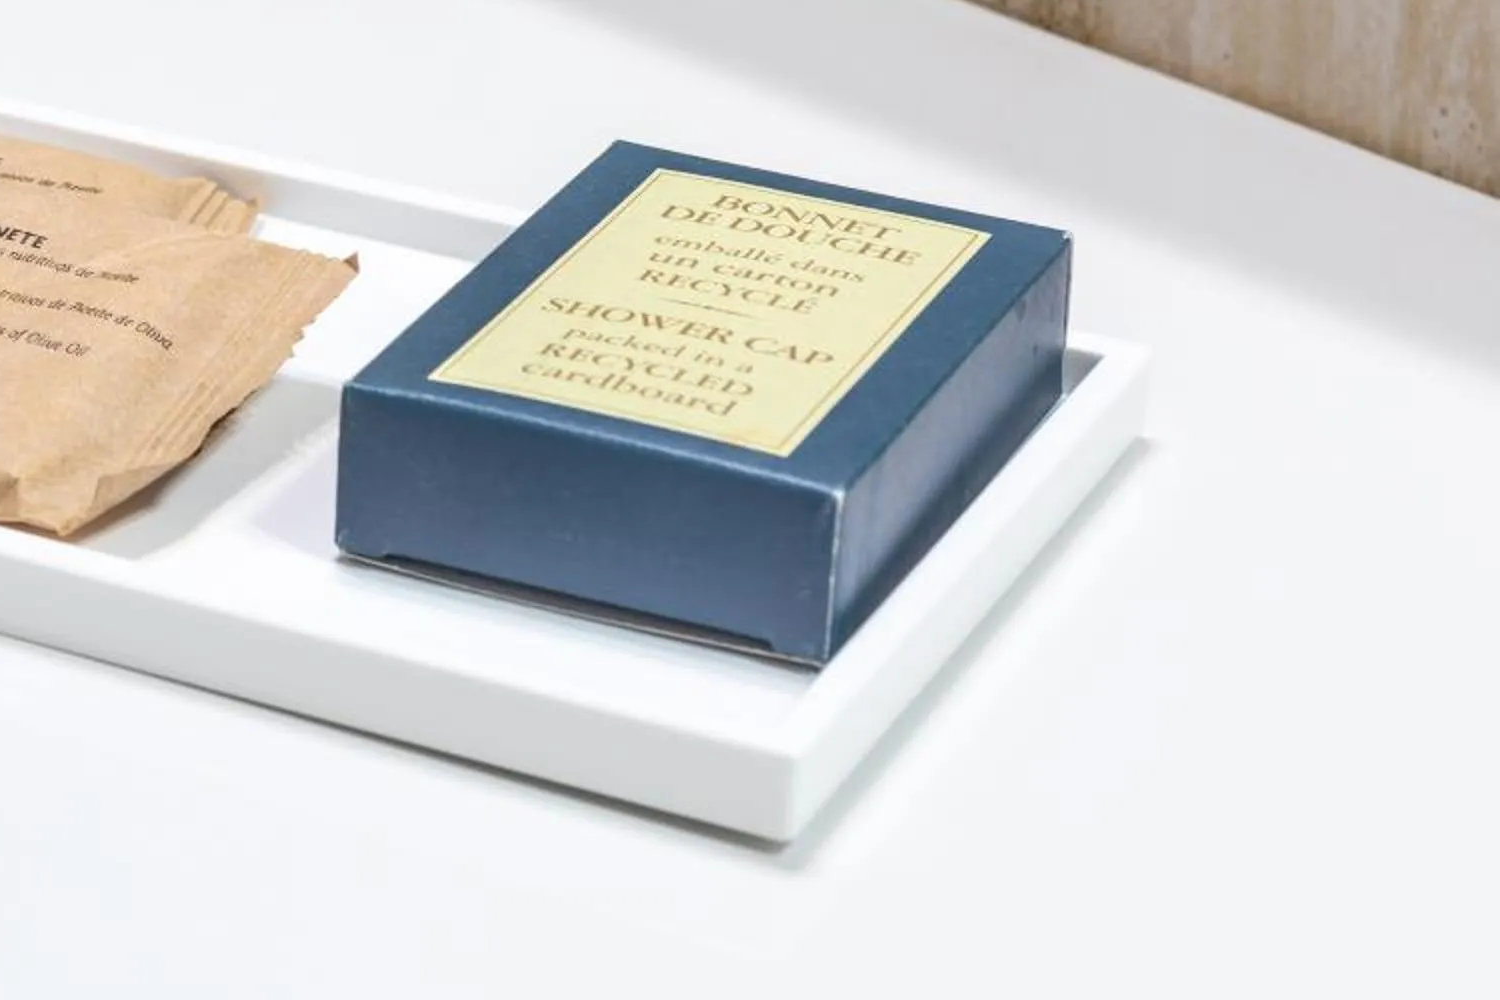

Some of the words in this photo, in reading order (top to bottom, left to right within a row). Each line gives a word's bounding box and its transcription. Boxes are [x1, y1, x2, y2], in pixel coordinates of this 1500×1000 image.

[660, 204, 723, 225] DE
[728, 216, 923, 267] DOUCHE
[711, 194, 902, 240] BONNET
[74, 264, 95, 279] de
[648, 251, 700, 270] un
[711, 262, 841, 299] carton
[653, 234, 785, 265] emballé
[789, 256, 868, 284] dans
[47, 298, 66, 311] de
[114, 314, 134, 328] de
[639, 268, 822, 315] RECYCLÉ
[7, 328, 29, 343] of
[25, 331, 63, 352] Olive
[64, 342, 92, 358] Oil
[540, 297, 736, 345] SHOWER
[743, 335, 836, 366] CAP
[562, 327, 688, 359] packed
[692, 349, 726, 369] in
[734, 362, 755, 375] a
[520, 361, 739, 418] cardboard
[539, 342, 755, 397] RECYCLED
